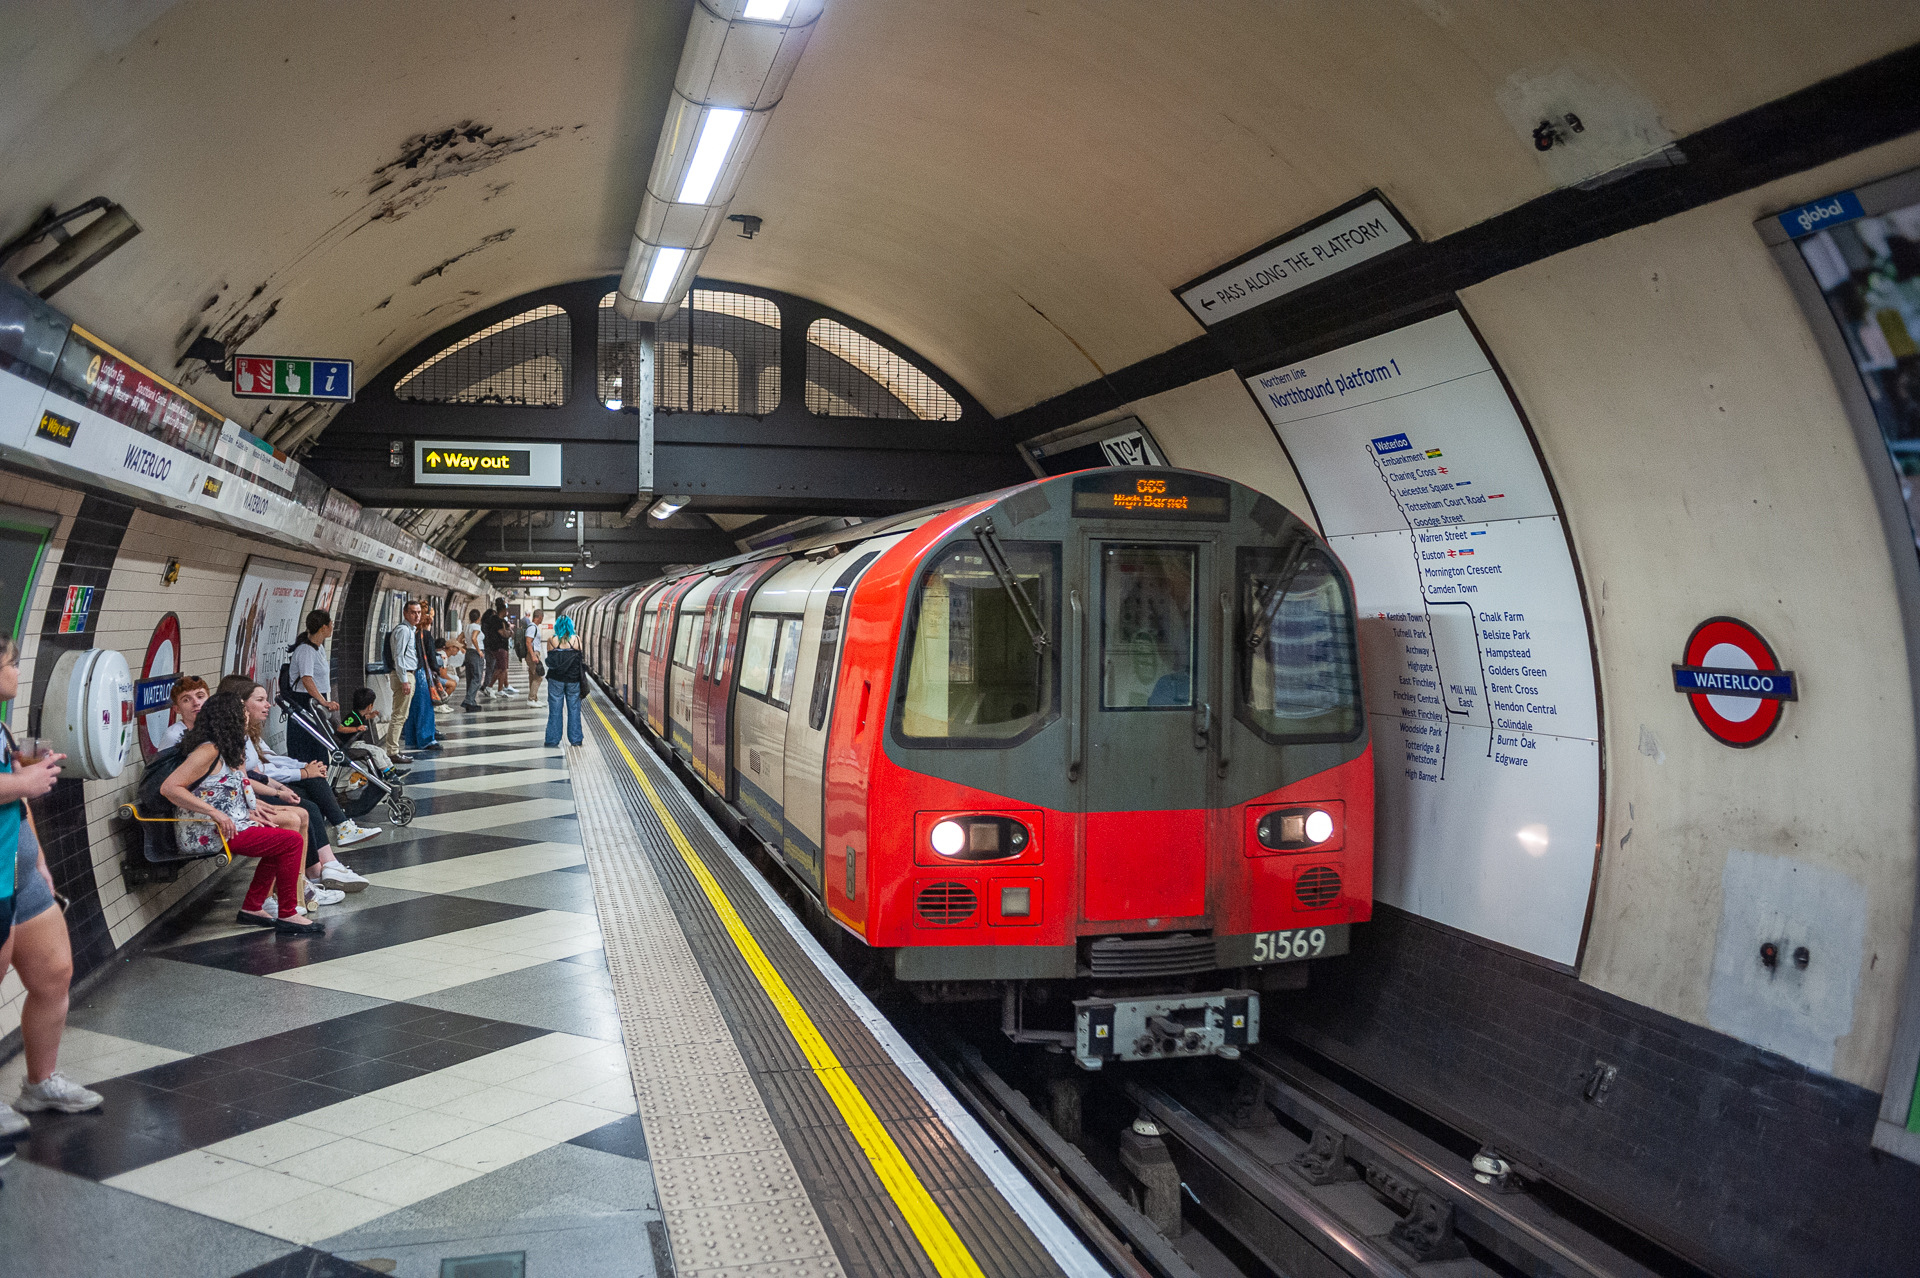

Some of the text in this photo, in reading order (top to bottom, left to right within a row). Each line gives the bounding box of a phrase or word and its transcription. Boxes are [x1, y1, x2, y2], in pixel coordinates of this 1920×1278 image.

[1797, 199, 1844, 231] global
[1216, 218, 1389, 304] PASS ALONG THE PLATFORM
[1259, 367, 1307, 389] Northern line
[1268, 358, 1401, 409] Northbound platform 1
[46, 418, 71, 438] Way out
[1375, 438, 1408, 452] Waterloo
[123, 444, 172, 481] WATERLOO
[443, 453, 510, 471] Way out
[1381, 453, 1425, 467] Embankment
[1390, 468, 1437, 482] Charing Cross
[1397, 486, 1429, 497] Leicester
[1429, 483, 1455, 494] Square
[242, 492, 268, 515] WATERLOO
[1113, 493, 1188, 510] High Barnet
[1405, 499, 1443, 512] Tottenham
[1443, 497, 1465, 507] Court
[1465, 494, 1487, 505] Road
[1413, 514, 1465, 527] Goodge Street
[1418, 533, 1443, 543] Warren
[1444, 531, 1468, 541] Street
[1421, 550, 1446, 560] Euston
[1424, 564, 1502, 578] Mornington Crescent
[1427, 583, 1478, 594] Camden Town
[1386, 612, 1424, 623] Kentish Town
[1479, 612, 1525, 622] Chalk Farm
[1393, 628, 1427, 639] Tufnell Park
[1482, 630, 1531, 640] Belsize Park
[1406, 645, 1430, 657] Archway
[1485, 647, 1531, 660] Hampstead
[1407, 661, 1433, 673] Highgate
[1488, 665, 1548, 677] Golders Green
[1399, 676, 1436, 690] East Finchley
[1491, 683, 1539, 695] Brent Cross
[1693, 672, 1774, 692] WATERLOO
[1450, 684, 1478, 696] Mill Hill
[1393, 690, 1440, 705] Finchley Central
[1458, 697, 1474, 708] East
[1401, 708, 1443, 721] West Finchley
[1494, 701, 1557, 715] Hendon Central
[1400, 723, 1443, 737] Woodside Park
[1497, 718, 1533, 731] Colindale
[1405, 740, 1440, 754] Totteridge &
[1497, 735, 1537, 749] Burnt Oak
[1406, 752, 1437, 765] Whetstone
[1495, 753, 1528, 767] Edgware
[1405, 768, 1438, 783] High Barnet
[1252, 928, 1326, 962] 51569
